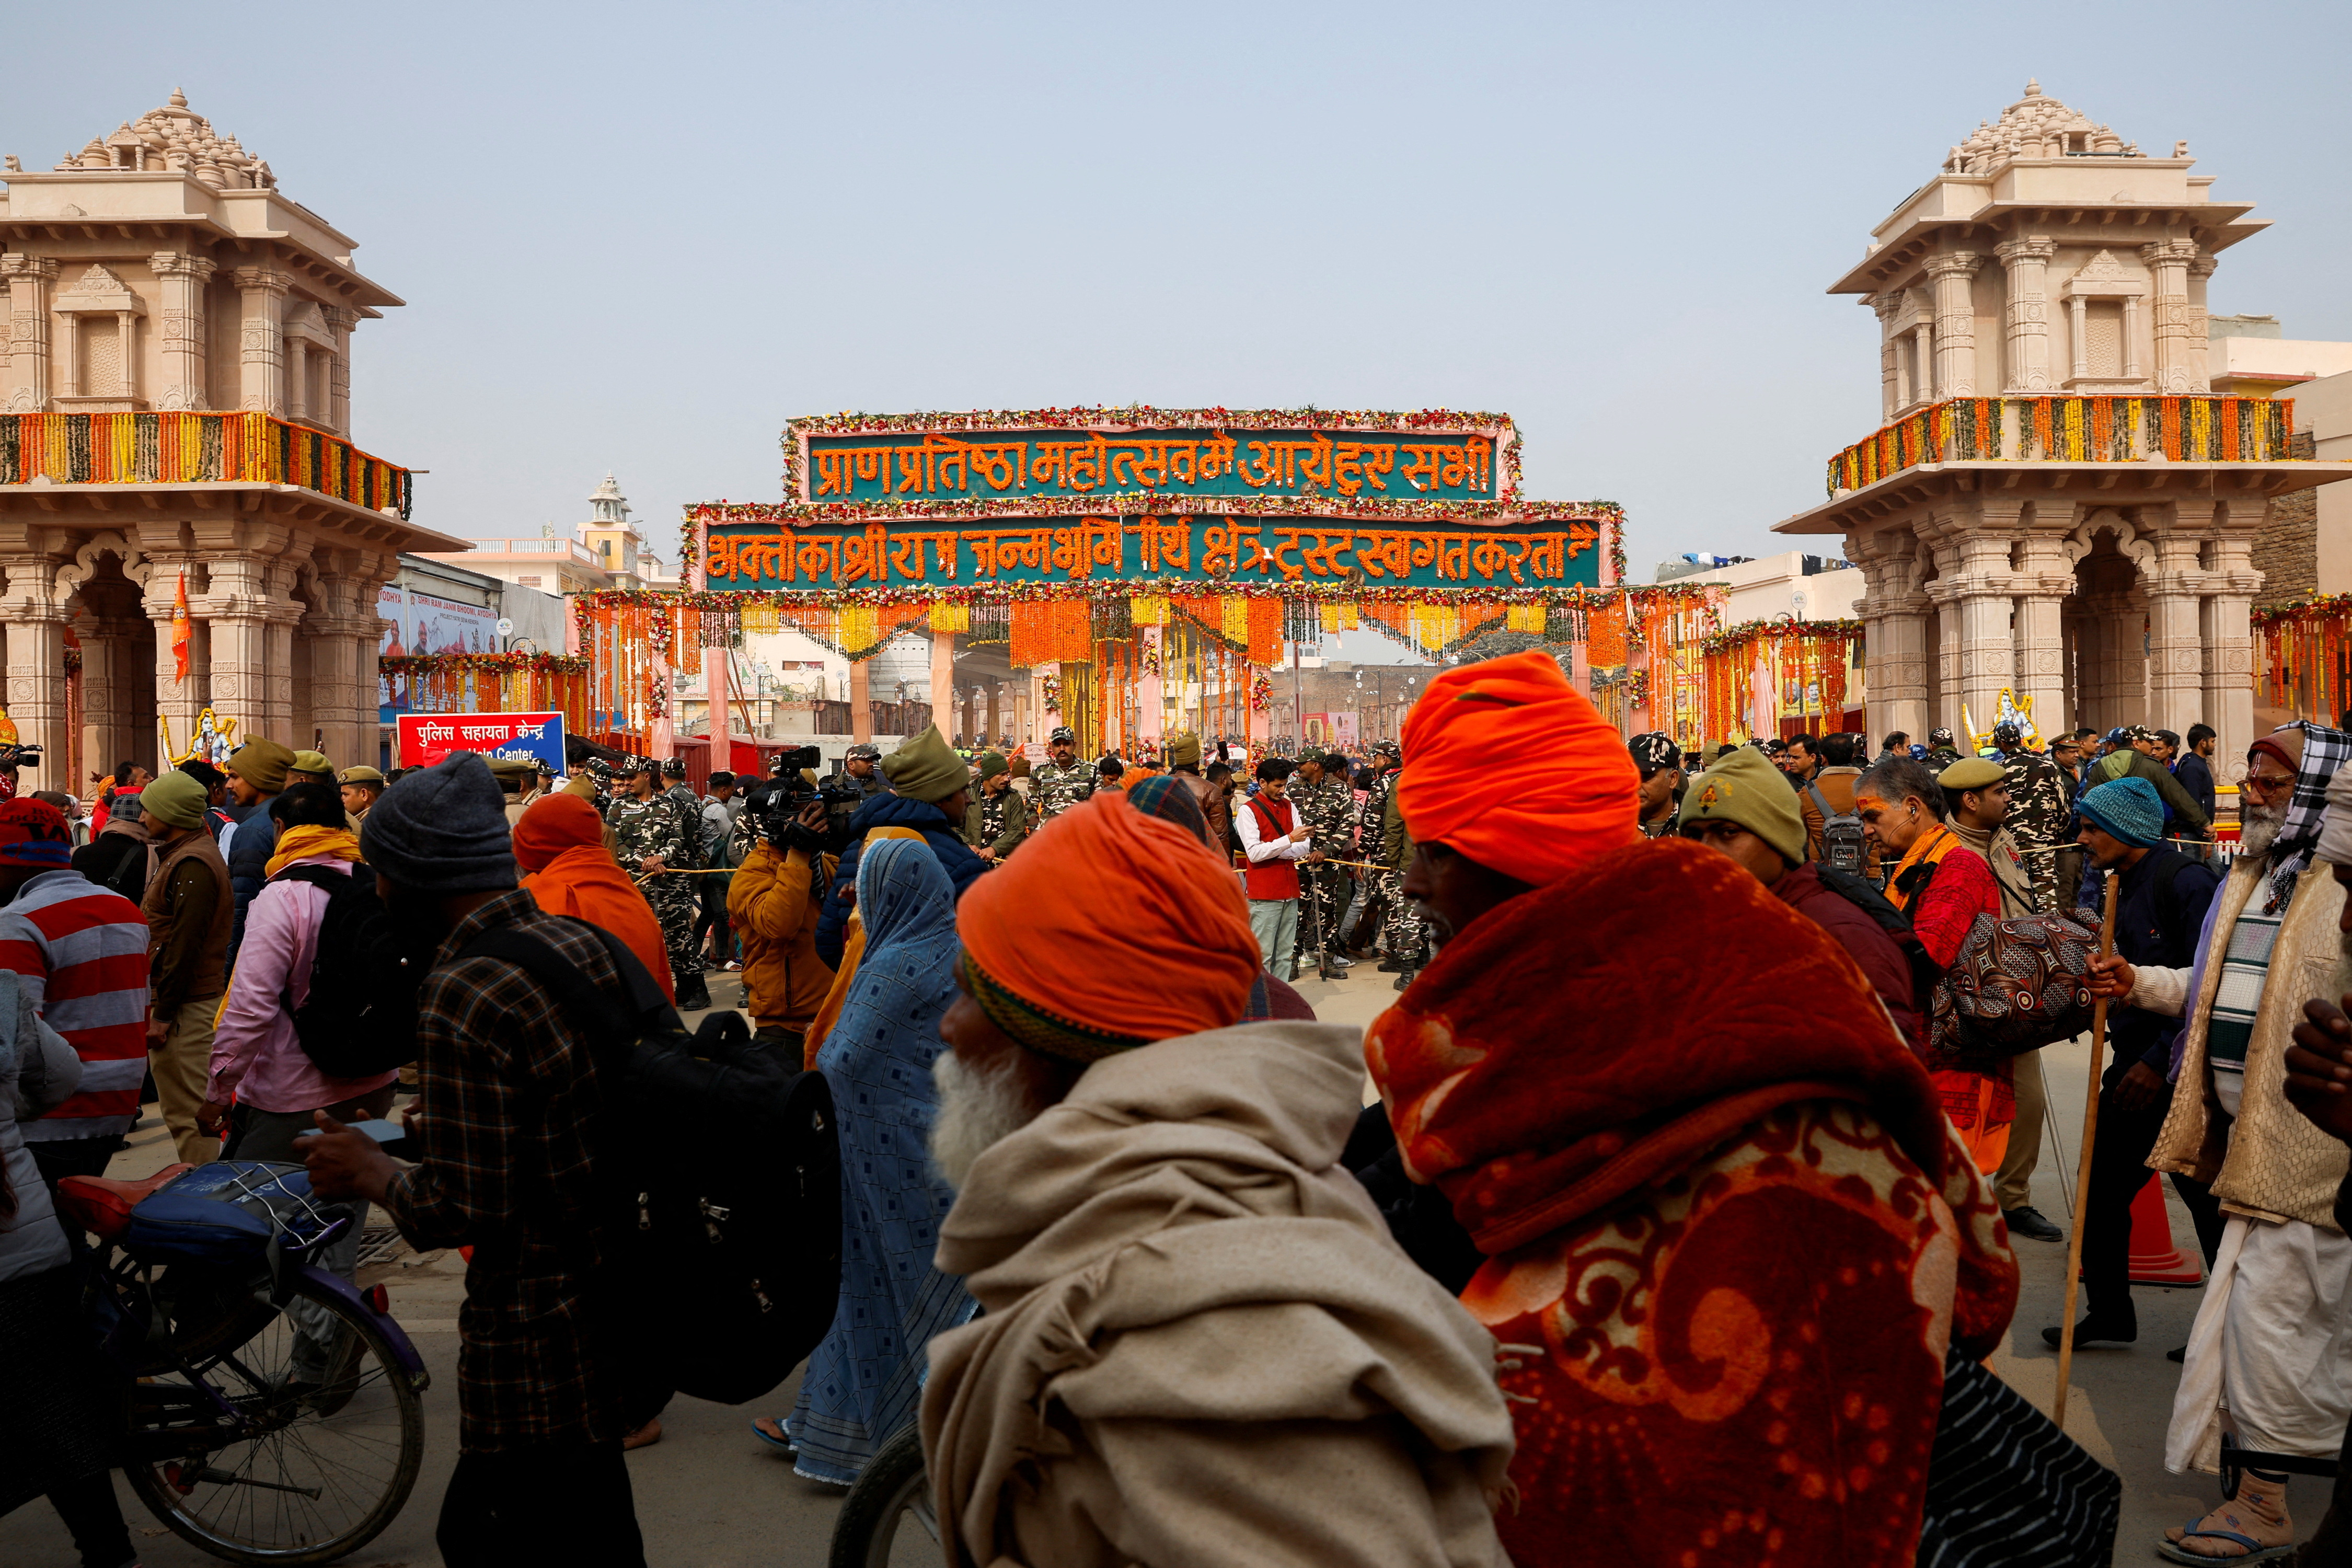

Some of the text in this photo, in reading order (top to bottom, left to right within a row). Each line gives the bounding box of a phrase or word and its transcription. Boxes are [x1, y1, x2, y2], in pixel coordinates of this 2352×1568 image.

[812, 446, 893, 496] प्राण
[895, 433, 1028, 493] प्रतिष्ठा
[1238, 431, 1333, 489] आये
[1401, 434, 1492, 493] सभी
[842, 523, 888, 582] श्री
[889, 531, 959, 580] राम
[1202, 516, 1273, 575] क्षेत्र
[1273, 527, 1355, 582] ट्रस्ट
[1356, 529, 1472, 581] स्वागत
[1472, 532, 1568, 585] करता
[378, 590, 402, 605] YODHYA
[418, 596, 497, 620] SHRI RAM JANM BHOOMI, AYODHYA
[416, 719, 545, 747] पुलिस सहायता केन्द्र
[497, 747, 533, 761] Center
